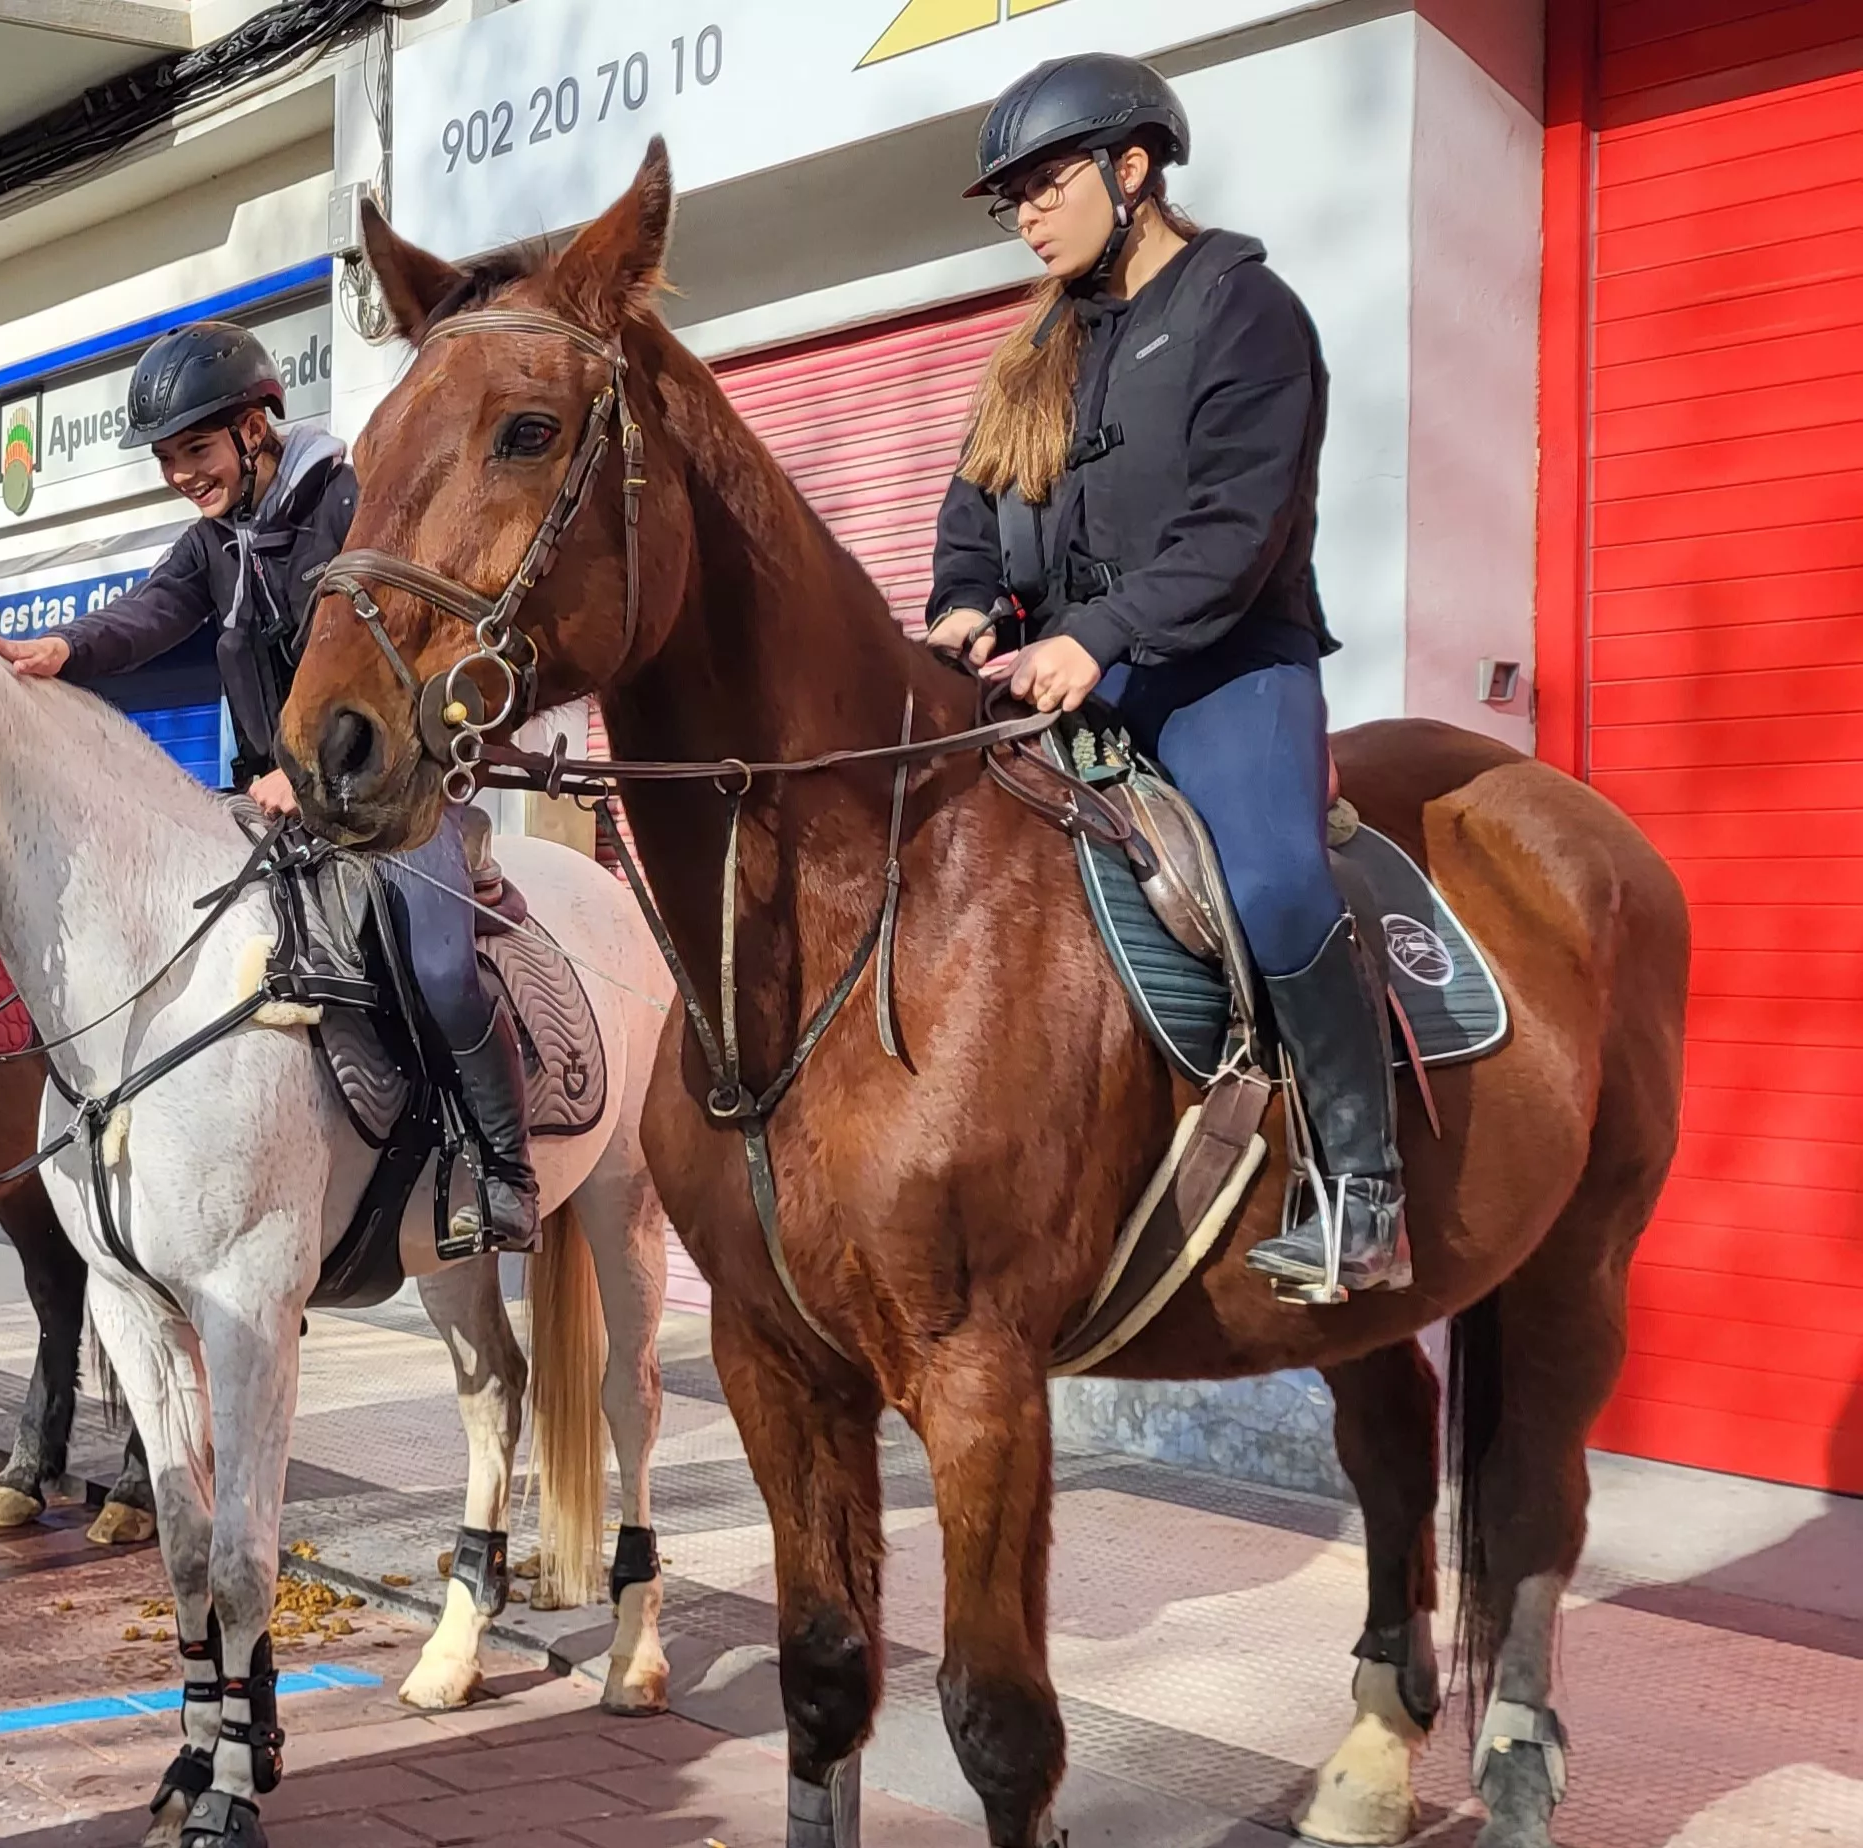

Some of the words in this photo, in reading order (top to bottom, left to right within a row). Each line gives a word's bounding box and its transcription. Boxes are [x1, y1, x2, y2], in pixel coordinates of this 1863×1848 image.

[442, 100, 514, 174] 902
[529, 76, 580, 146] 20
[597, 51, 649, 122] 70
[671, 24, 723, 95] 10
[48, 405, 126, 462] Apues
